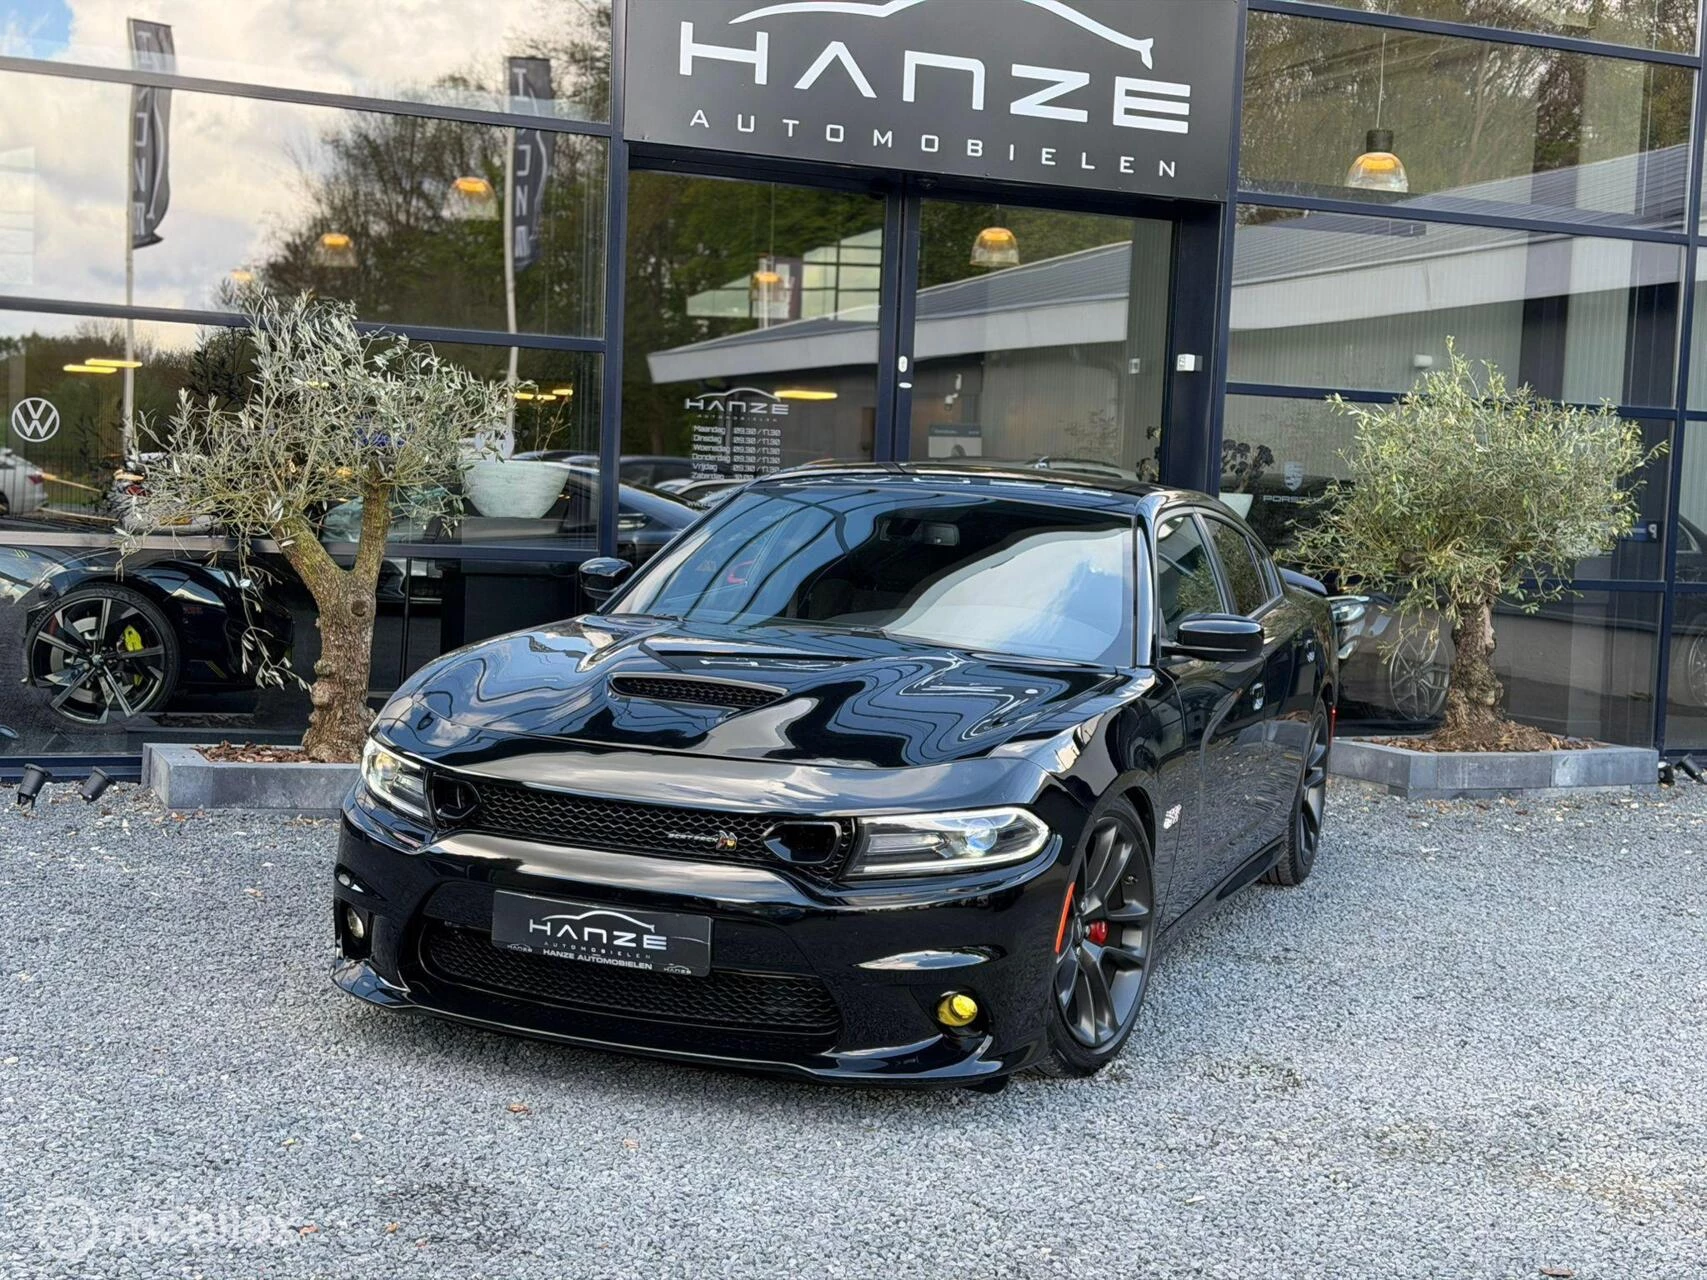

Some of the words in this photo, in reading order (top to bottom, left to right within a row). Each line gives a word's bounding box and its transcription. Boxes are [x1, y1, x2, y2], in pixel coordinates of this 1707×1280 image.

[679, 20, 1191, 134] HANZE
[690, 109, 1176, 178] AUTOMOBIELEN
[513, 67, 532, 258] HNZE
[684, 398, 789, 415] HANZE
[693, 426, 726, 436] Maandag
[693, 435, 722, 444] Dinsdag
[693, 445, 731, 455] Woensdag
[692, 454, 731, 464] Donderdag
[693, 463, 718, 473] Vrijdag
[1263, 495, 1326, 504] PORSC
[529, 919, 667, 950] HANZE
[544, 941, 651, 959] AUTOMOBIELEN
[543, 948, 575, 960] HANZE
[577, 954, 653, 970] AUTOMOBIELEN
